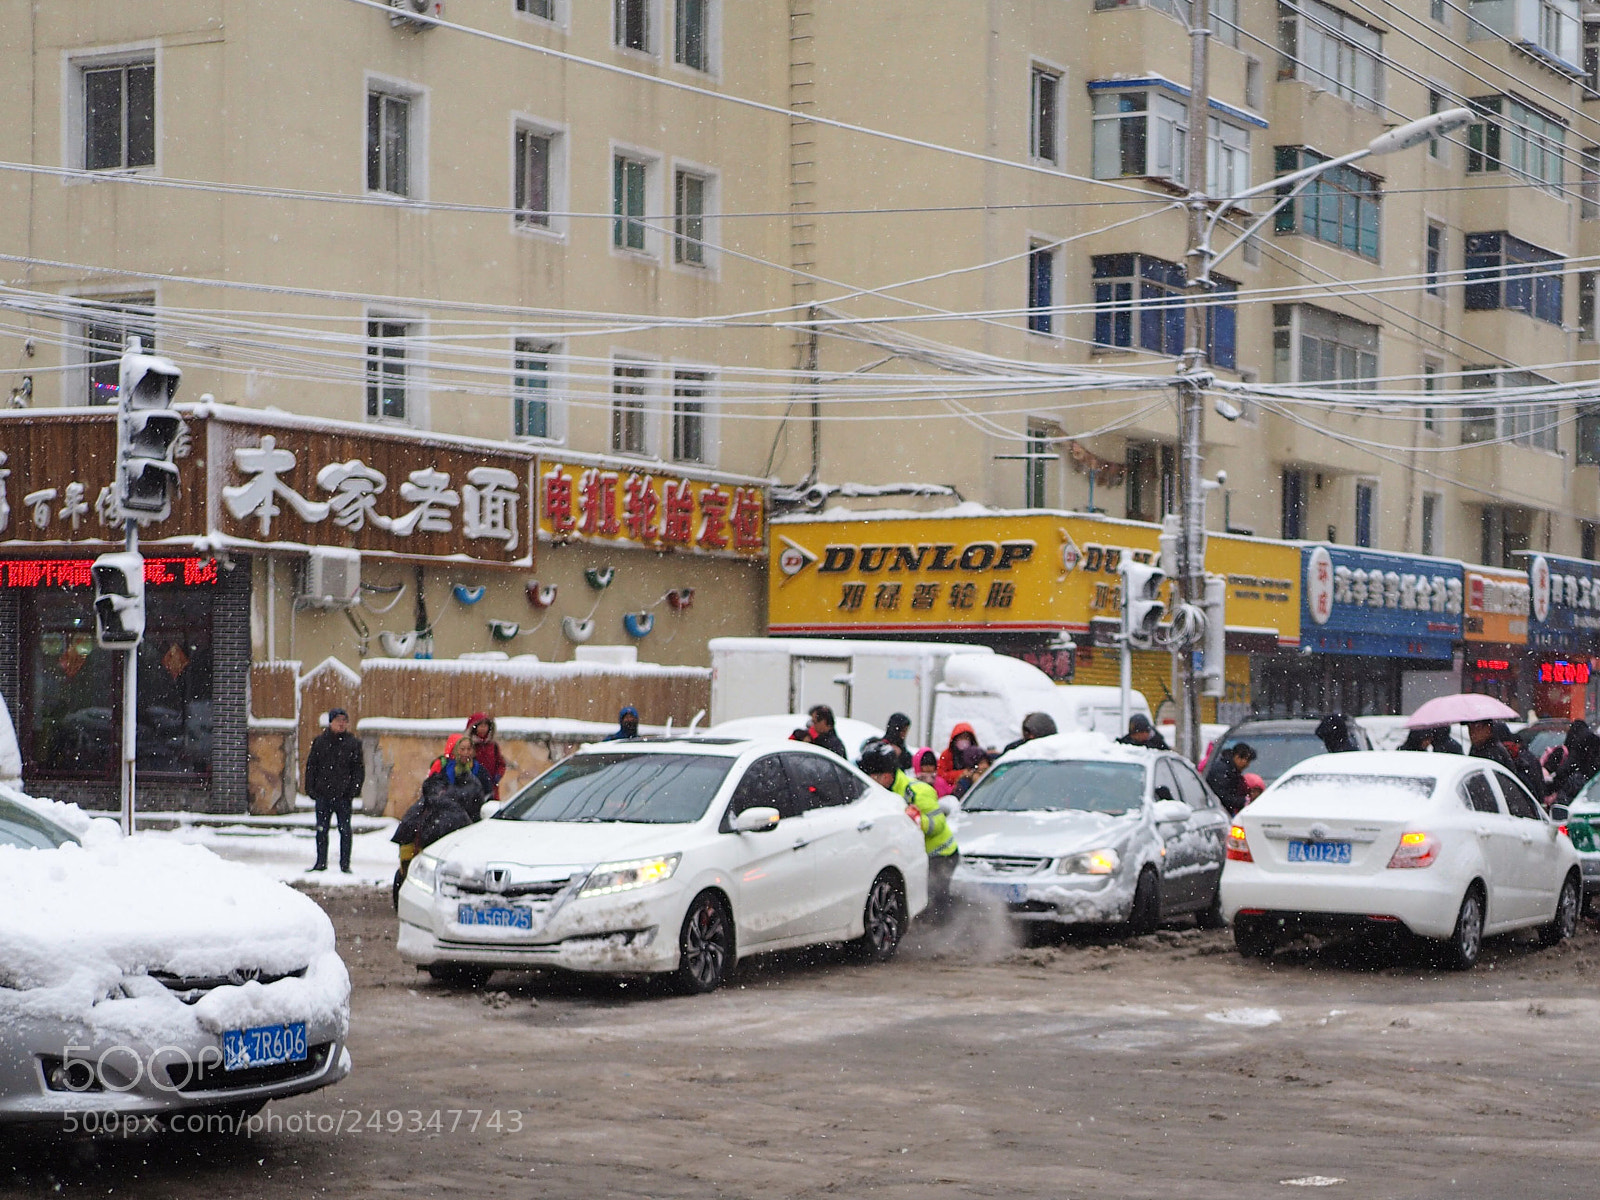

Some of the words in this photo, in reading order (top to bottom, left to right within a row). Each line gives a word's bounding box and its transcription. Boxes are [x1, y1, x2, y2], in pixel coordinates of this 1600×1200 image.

[222, 434, 520, 550] 本家老面
[818, 540, 1036, 573] DUNLOP
[838, 581, 1016, 609] 邓禄普轮胎
